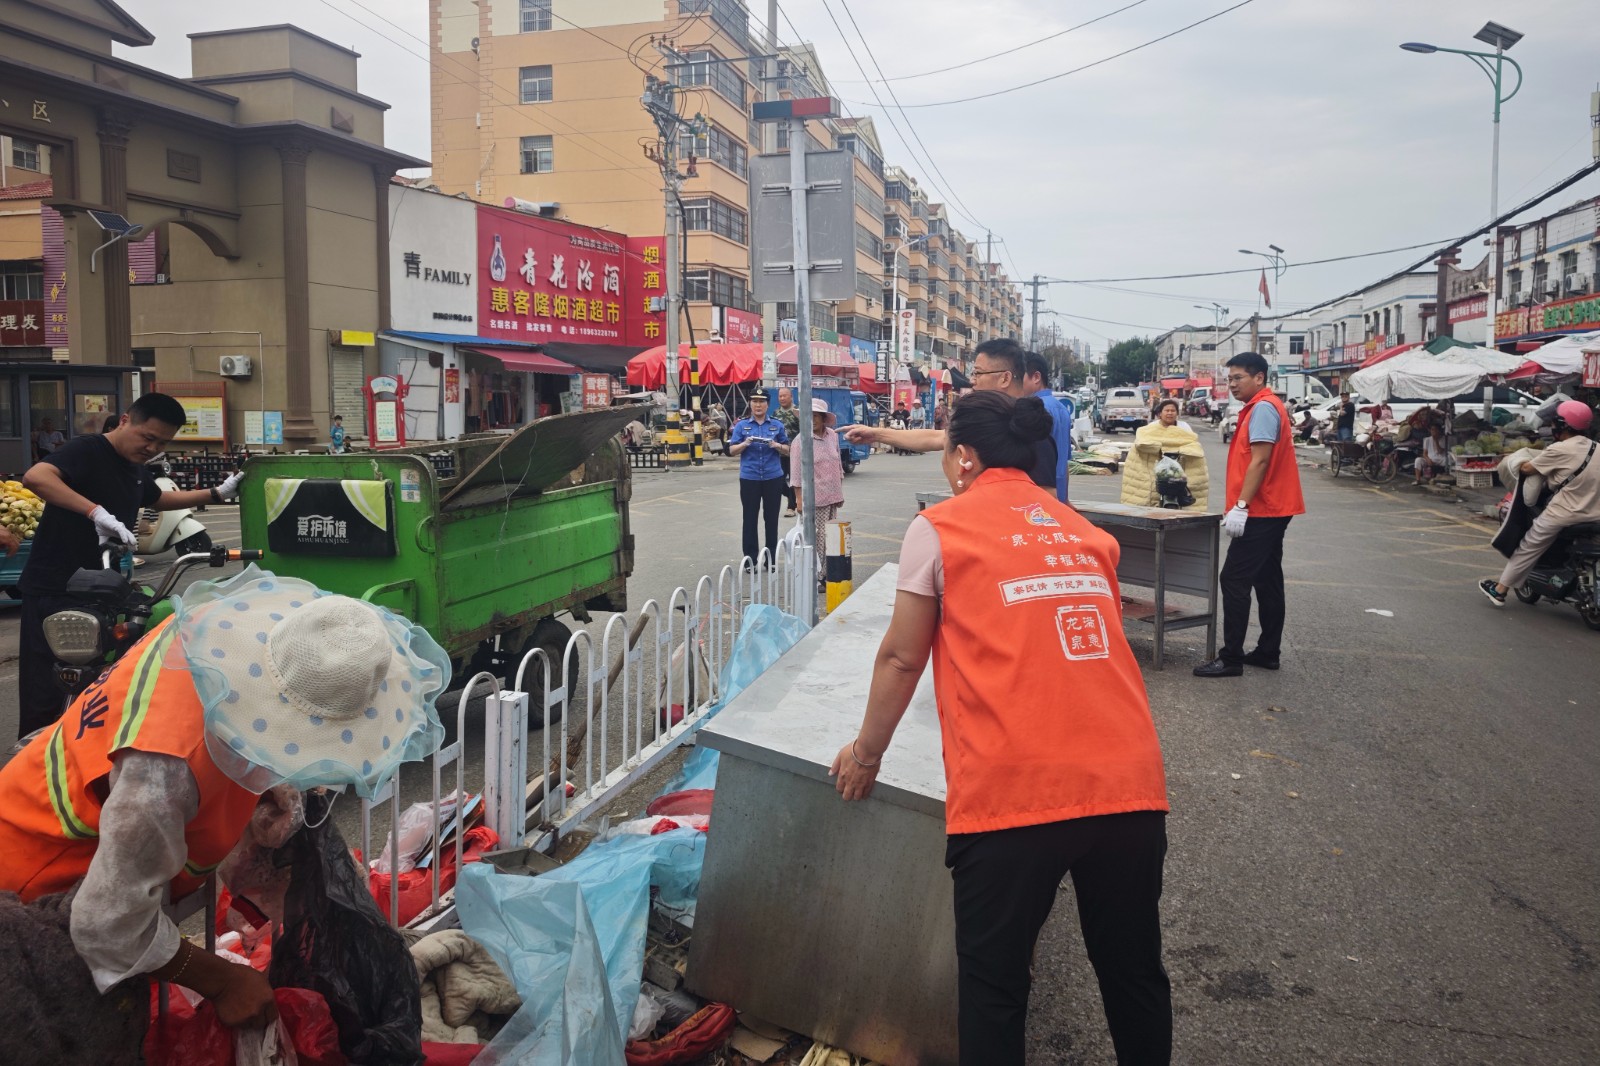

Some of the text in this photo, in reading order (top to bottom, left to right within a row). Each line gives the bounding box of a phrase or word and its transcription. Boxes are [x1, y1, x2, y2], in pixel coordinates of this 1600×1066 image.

[404, 251, 421, 279] 青
[518, 247, 621, 296] 青花汾酒
[424, 268, 472, 286] FAMILY
[490, 286, 620, 325] 惠客隆烟酒超市
[489, 318, 518, 330] 名烟名酒
[585, 377, 608, 390] 雪糕
[585, 393, 608, 406] 批发
[297, 514, 347, 538] 爱护环境
